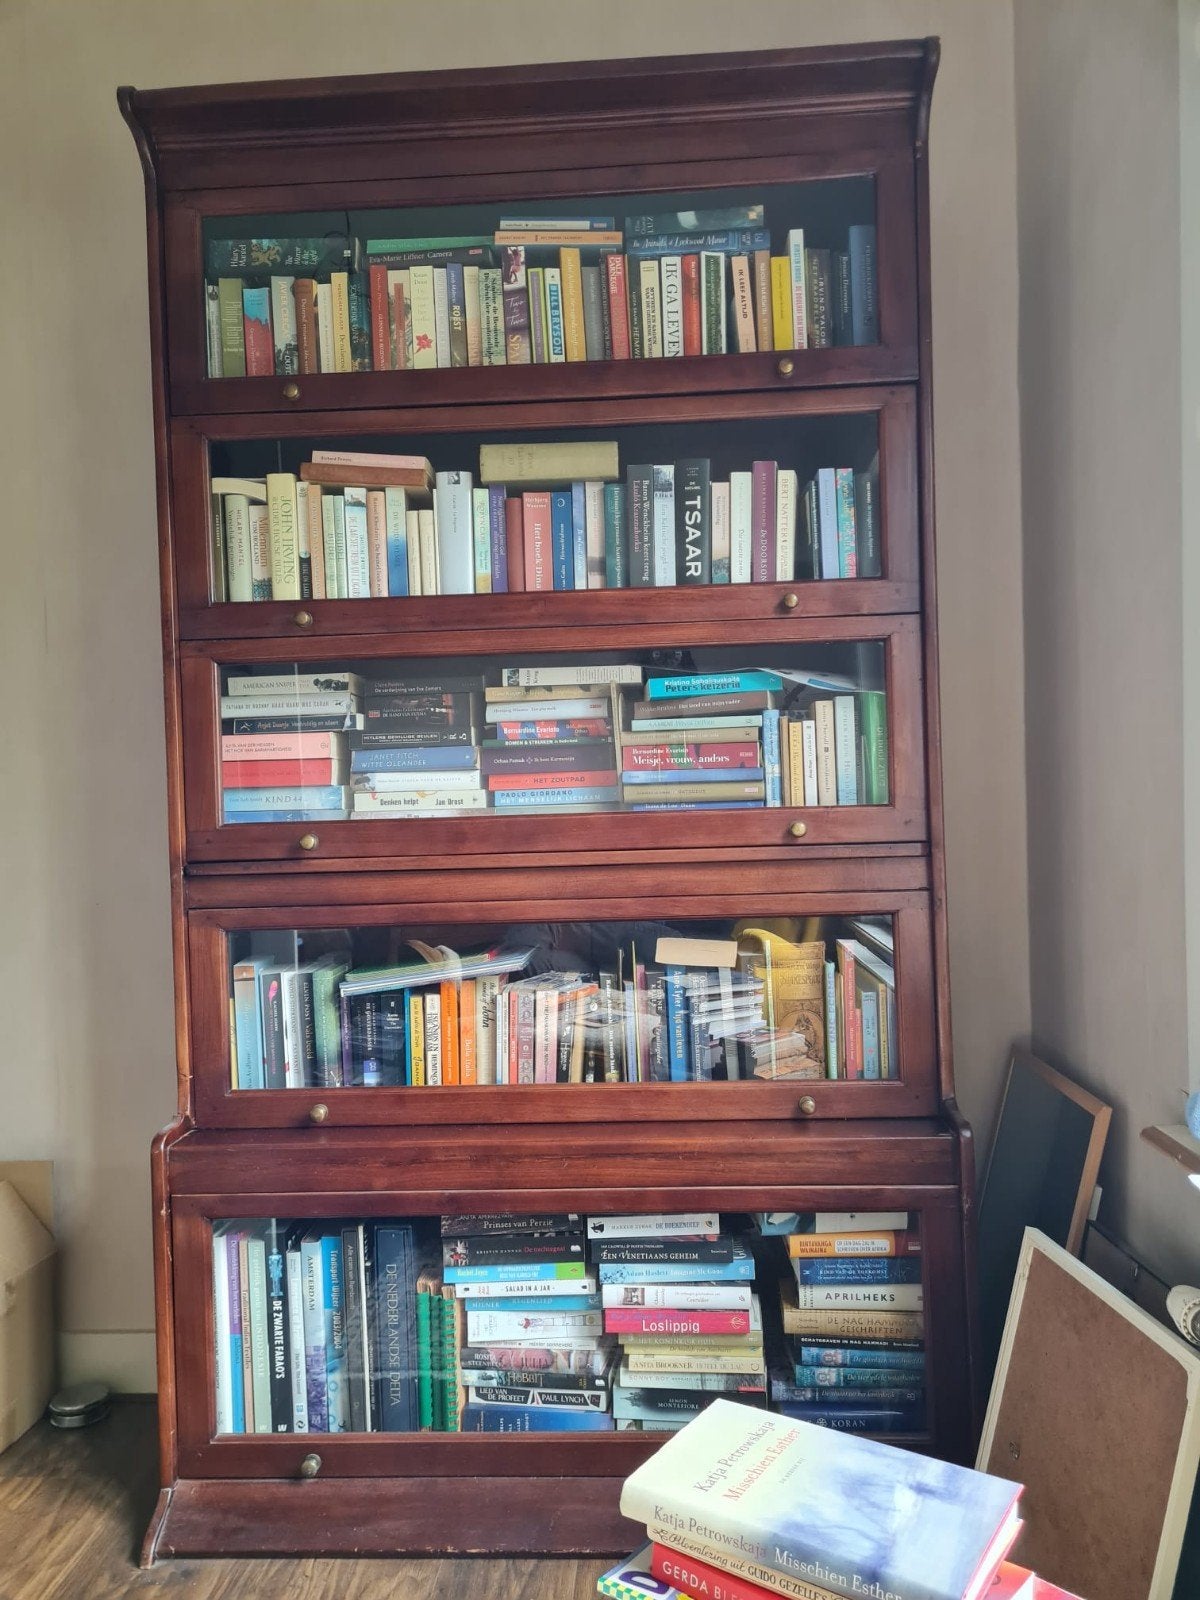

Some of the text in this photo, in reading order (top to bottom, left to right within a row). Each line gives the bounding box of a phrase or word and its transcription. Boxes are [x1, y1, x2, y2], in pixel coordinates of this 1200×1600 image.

[666, 262, 676, 279] IK
[277, 281, 289, 305] JAVIER
[666, 284, 676, 305] GA
[223, 301, 243, 345] Philip Roth
[452, 305, 461, 330] ROEST
[550, 284, 562, 354] BILL BRYSON
[272, 504, 280, 528] CIDER
[258, 517, 268, 567] Millennium
[273, 529, 281, 555] HOUSE
[279, 496, 296, 584] JOHN IRVING
[534, 523, 542, 540] Het
[685, 495, 701, 576] TSAAR
[535, 541, 543, 564] boek
[665, 682, 740, 693] Peters keizerin
[632, 754, 729, 767] Meisje, vrouw, anders
[673, 971, 681, 989] Anne
[671, 990, 681, 1007] Tyler
[482, 1006, 495, 1028] John
[673, 1011, 682, 1023] Tijd
[483, 1220, 511, 1229] Prinses
[530, 1219, 553, 1227] Perzië
[230, 1241, 236, 1250] De
[619, 1250, 669, 1260] VENETIAANS
[307, 1255, 315, 1311] AMSTERDAM
[330, 1285, 338, 1307] Wijzer
[330, 1311, 342, 1349] 2003/2004
[386, 1264, 401, 1406] DE NEDERLANDSE DELTA
[642, 1319, 700, 1333] Loslippig
[840, 1326, 903, 1334] GESCHRIFTEN
[273, 1300, 284, 1379] DE ZWARTE FARAO'S
[498, 1394, 525, 1402] PROFEET
[560, 1395, 585, 1404] LYNCH
[693, 1420, 775, 1492] Katja Petrowskaja
[723, 1427, 801, 1502] Misschien Esther
[654, 1505, 685, 1530] Katja
[689, 1517, 767, 1560] Petrowskaja
[774, 1547, 847, 1587] Misschien
[662, 1561, 709, 1595] GERDA
[730, 1560, 746, 1571] uit
[747, 1565, 776, 1585] GUIDO
